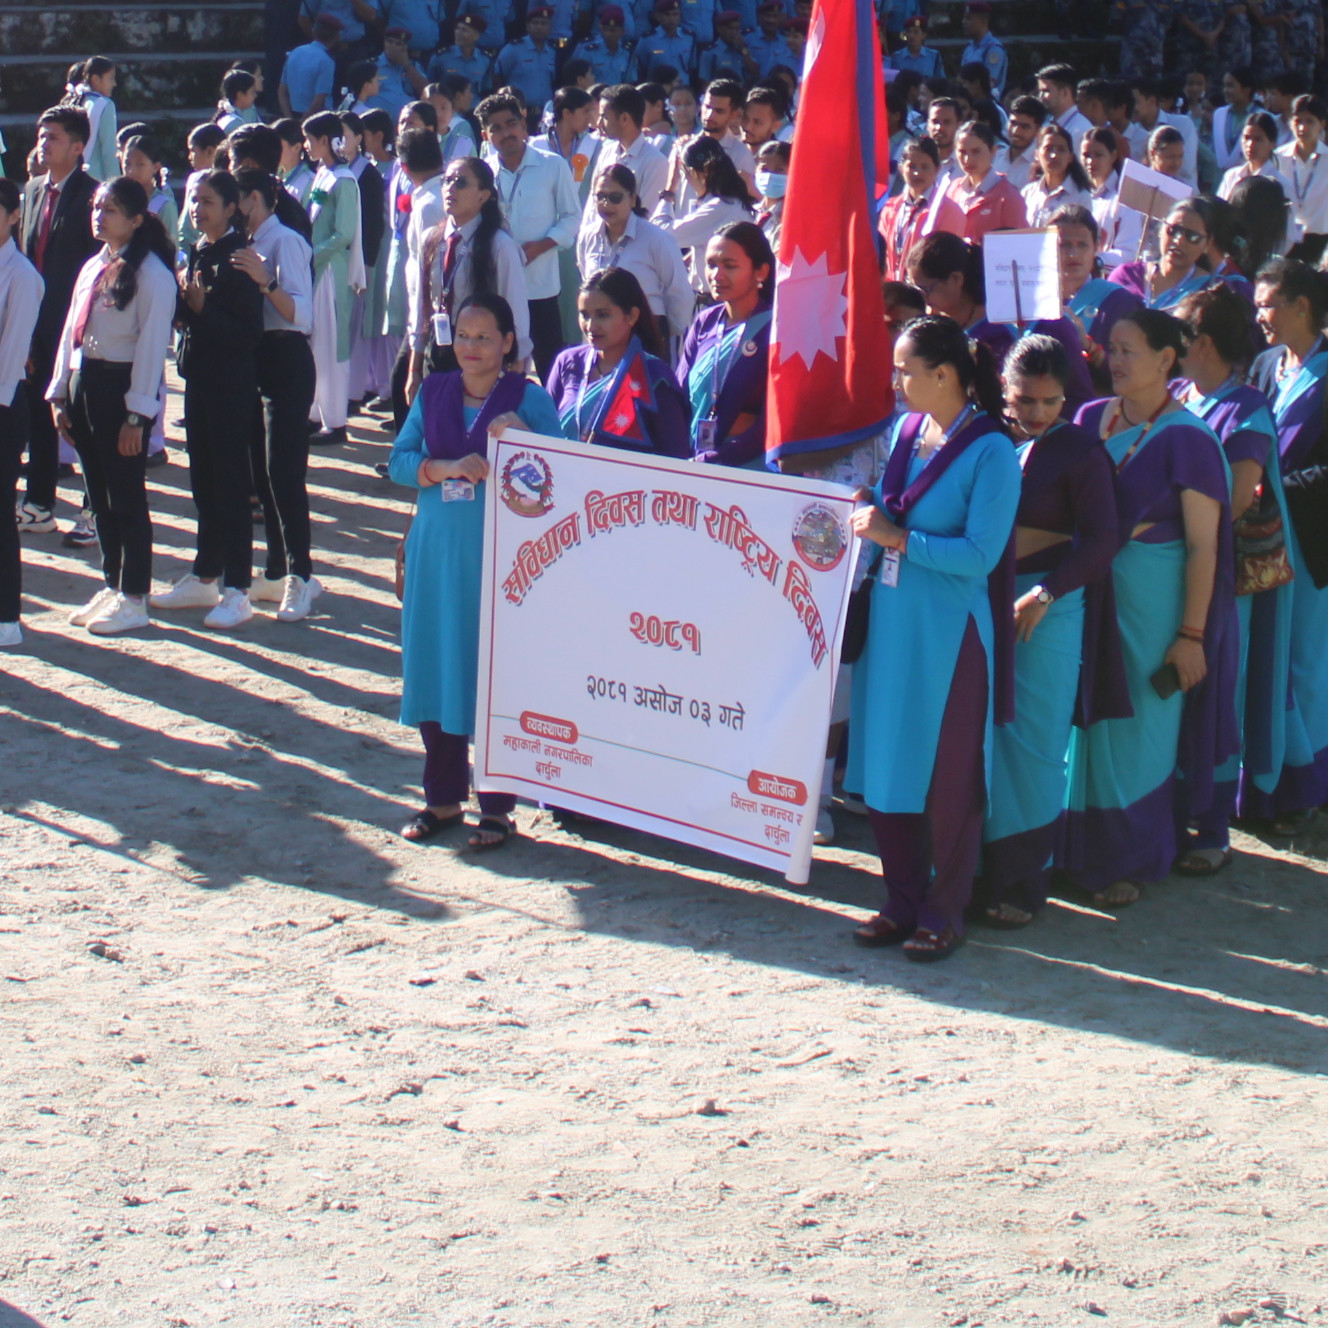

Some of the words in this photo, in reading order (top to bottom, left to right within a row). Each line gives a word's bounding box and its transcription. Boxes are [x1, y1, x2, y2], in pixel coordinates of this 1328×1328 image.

[502, 512, 581, 607] संविधान
[585, 489, 648, 539] दिवस
[651, 489, 701, 531] तथा
[703, 501, 783, 587] राष्ट्रिय
[782, 560, 829, 671] दिवस
[629, 611, 701, 656] २०८१
[587, 675, 627, 702] २०८१
[634, 684, 684, 715] असोज
[690, 699, 711, 727] ०३
[719, 701, 746, 730] गते
[526, 717, 572, 739] व्यवस्थापक
[503, 734, 541, 754] महाकाली
[544, 744, 593, 767] नगरपालिका
[535, 761, 561, 780] दार्चुला
[758, 777, 797, 799] आयोजक
[731, 792, 758, 814] जिल्ला
[760, 803, 794, 824] समन्वय
[764, 824, 790, 846] दार्चुला
